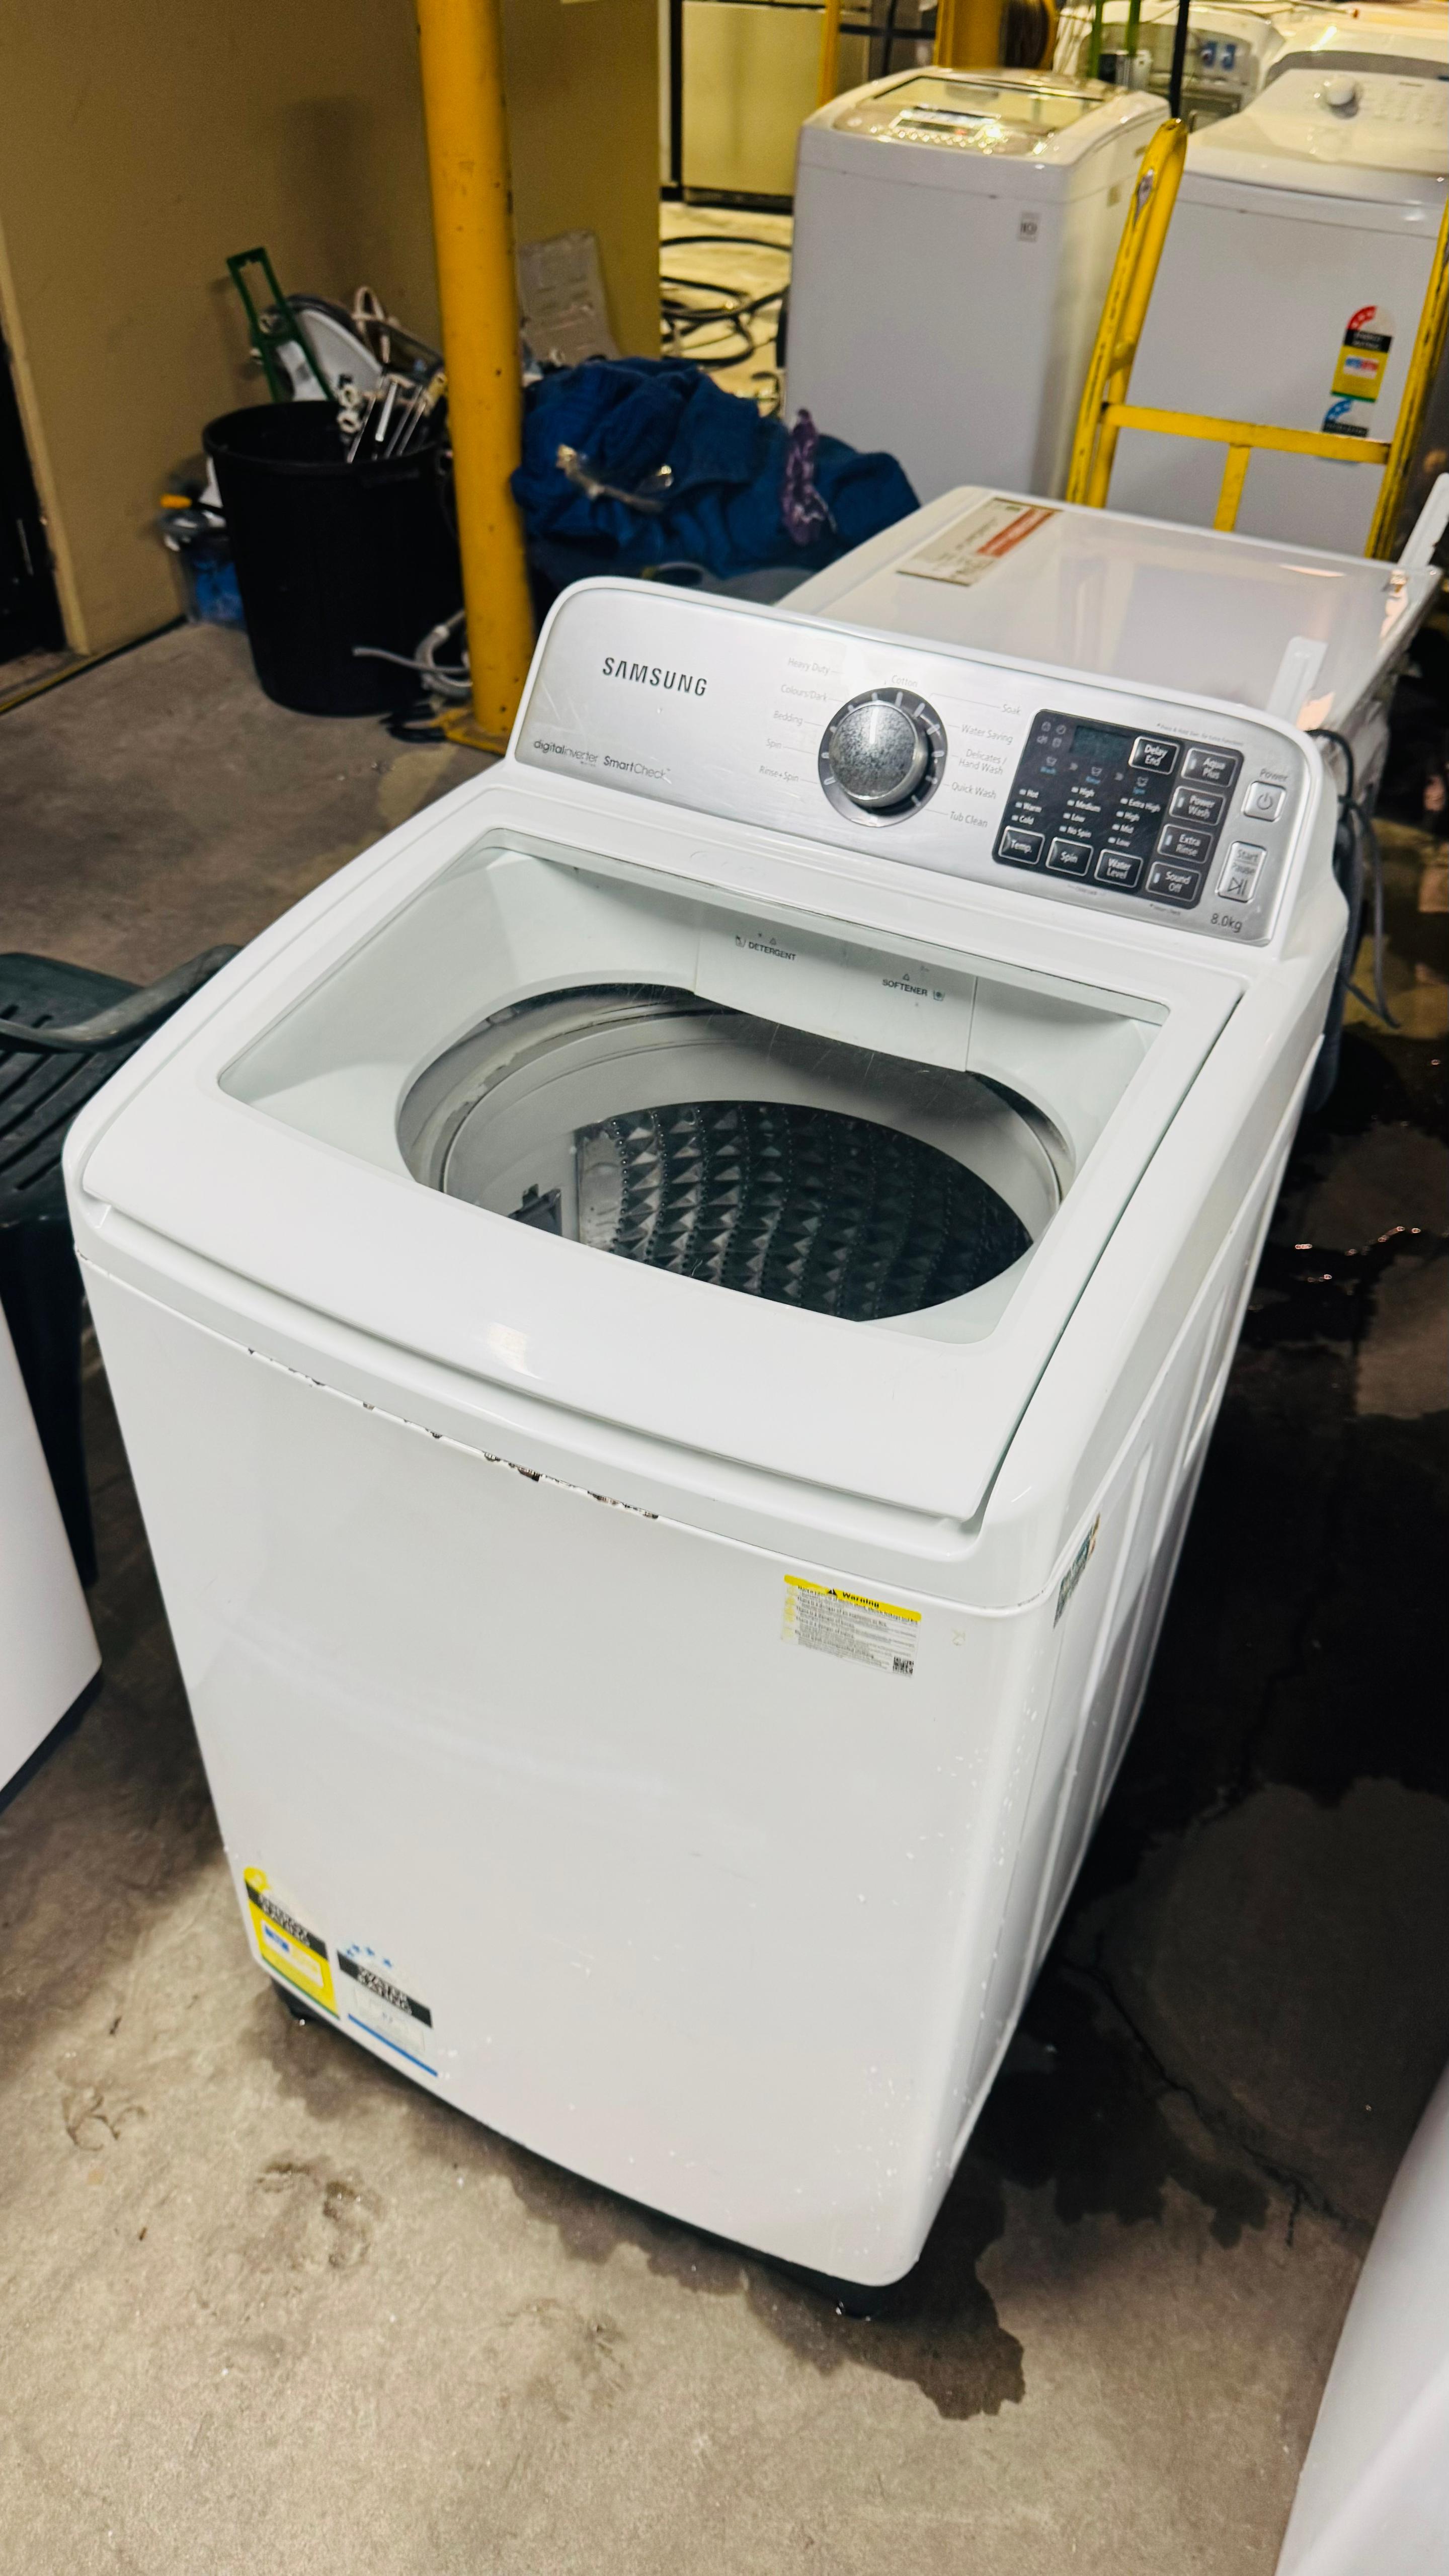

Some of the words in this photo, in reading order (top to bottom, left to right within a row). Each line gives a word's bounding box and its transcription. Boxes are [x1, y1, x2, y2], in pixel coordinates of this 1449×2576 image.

[787, 658, 810, 671] Heavy
[812, 663, 830, 676] Duty
[603, 657, 707, 696] SAMSUNG
[892, 675, 918, 688] Cotton
[1002, 704, 1021, 715] Soak
[773, 710, 803, 727] Bedding
[961, 724, 985, 736] Water
[987, 730, 1014, 745] Saving
[766, 738, 782, 750] Spin
[1144, 744, 1169, 758] Delay
[966, 749, 1001, 764] Delicates
[1145, 755, 1161, 766] End
[958, 759, 980, 771] Hand
[982, 763, 1004, 775] Wash
[1202, 758, 1226, 771] Aqua
[759, 765, 799, 782] Rinse+Spin
[1202, 768, 1220, 780] Plus
[1259, 767, 1289, 781] Power
[951, 782, 973, 794] Quick
[975, 787, 996, 799] Wash
[1189, 795, 1216, 809] Power
[1188, 805, 1211, 819] Wash
[950, 811, 964, 822] Tub
[965, 815, 988, 828] Clean
[1011, 839, 1032, 854] Temp.
[1179, 833, 1201, 846] Extra
[1060, 851, 1079, 864] Spin
[1175, 844, 1198, 857] Rinse
[1108, 857, 1132, 871] Water
[1106, 867, 1129, 880] Level
[1165, 871, 1192, 885] Sound
[1168, 882, 1183, 893] Off
[1211, 913, 1243, 933] 8.0kg
[748, 941, 796, 961] DETERGENT
[882, 978, 928, 996] SOFTENER
[842, 1591, 880, 1608] Warning
